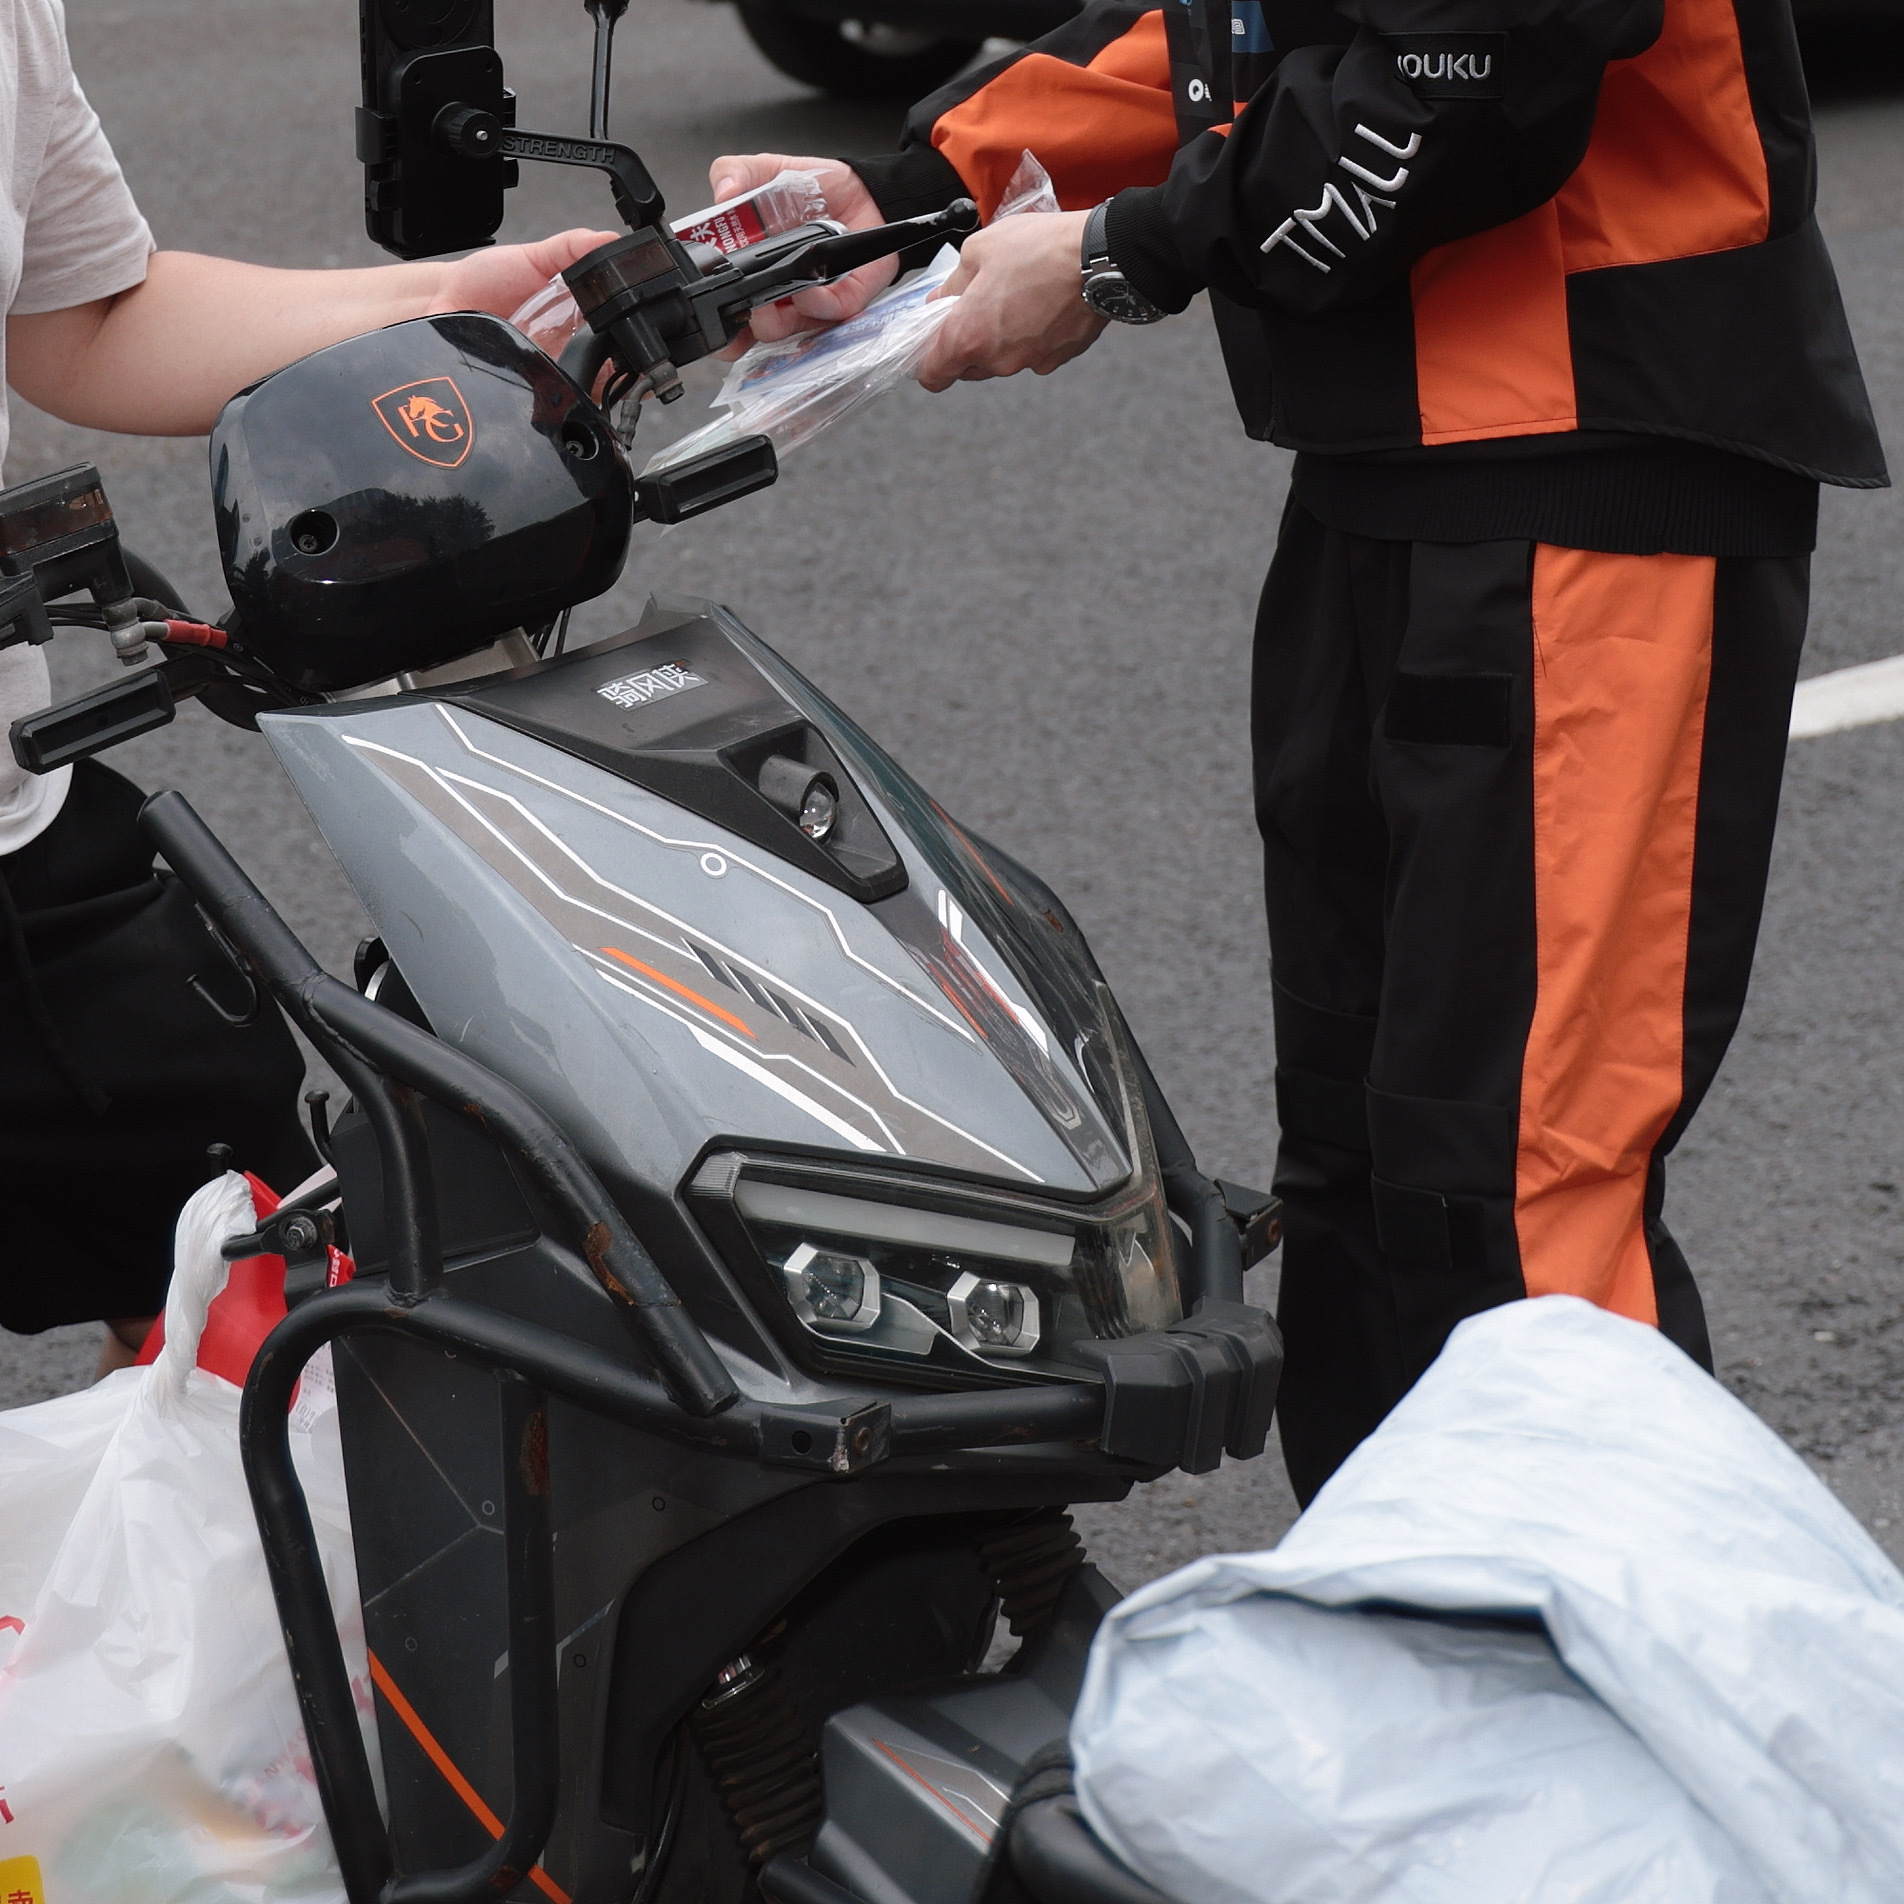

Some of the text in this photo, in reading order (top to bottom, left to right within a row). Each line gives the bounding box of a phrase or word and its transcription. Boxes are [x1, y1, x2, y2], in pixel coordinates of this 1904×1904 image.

[502, 135, 617, 165] STRENGTH
[1260, 123, 1423, 275] TMALL
[597, 663, 701, 708] 骑风侠
